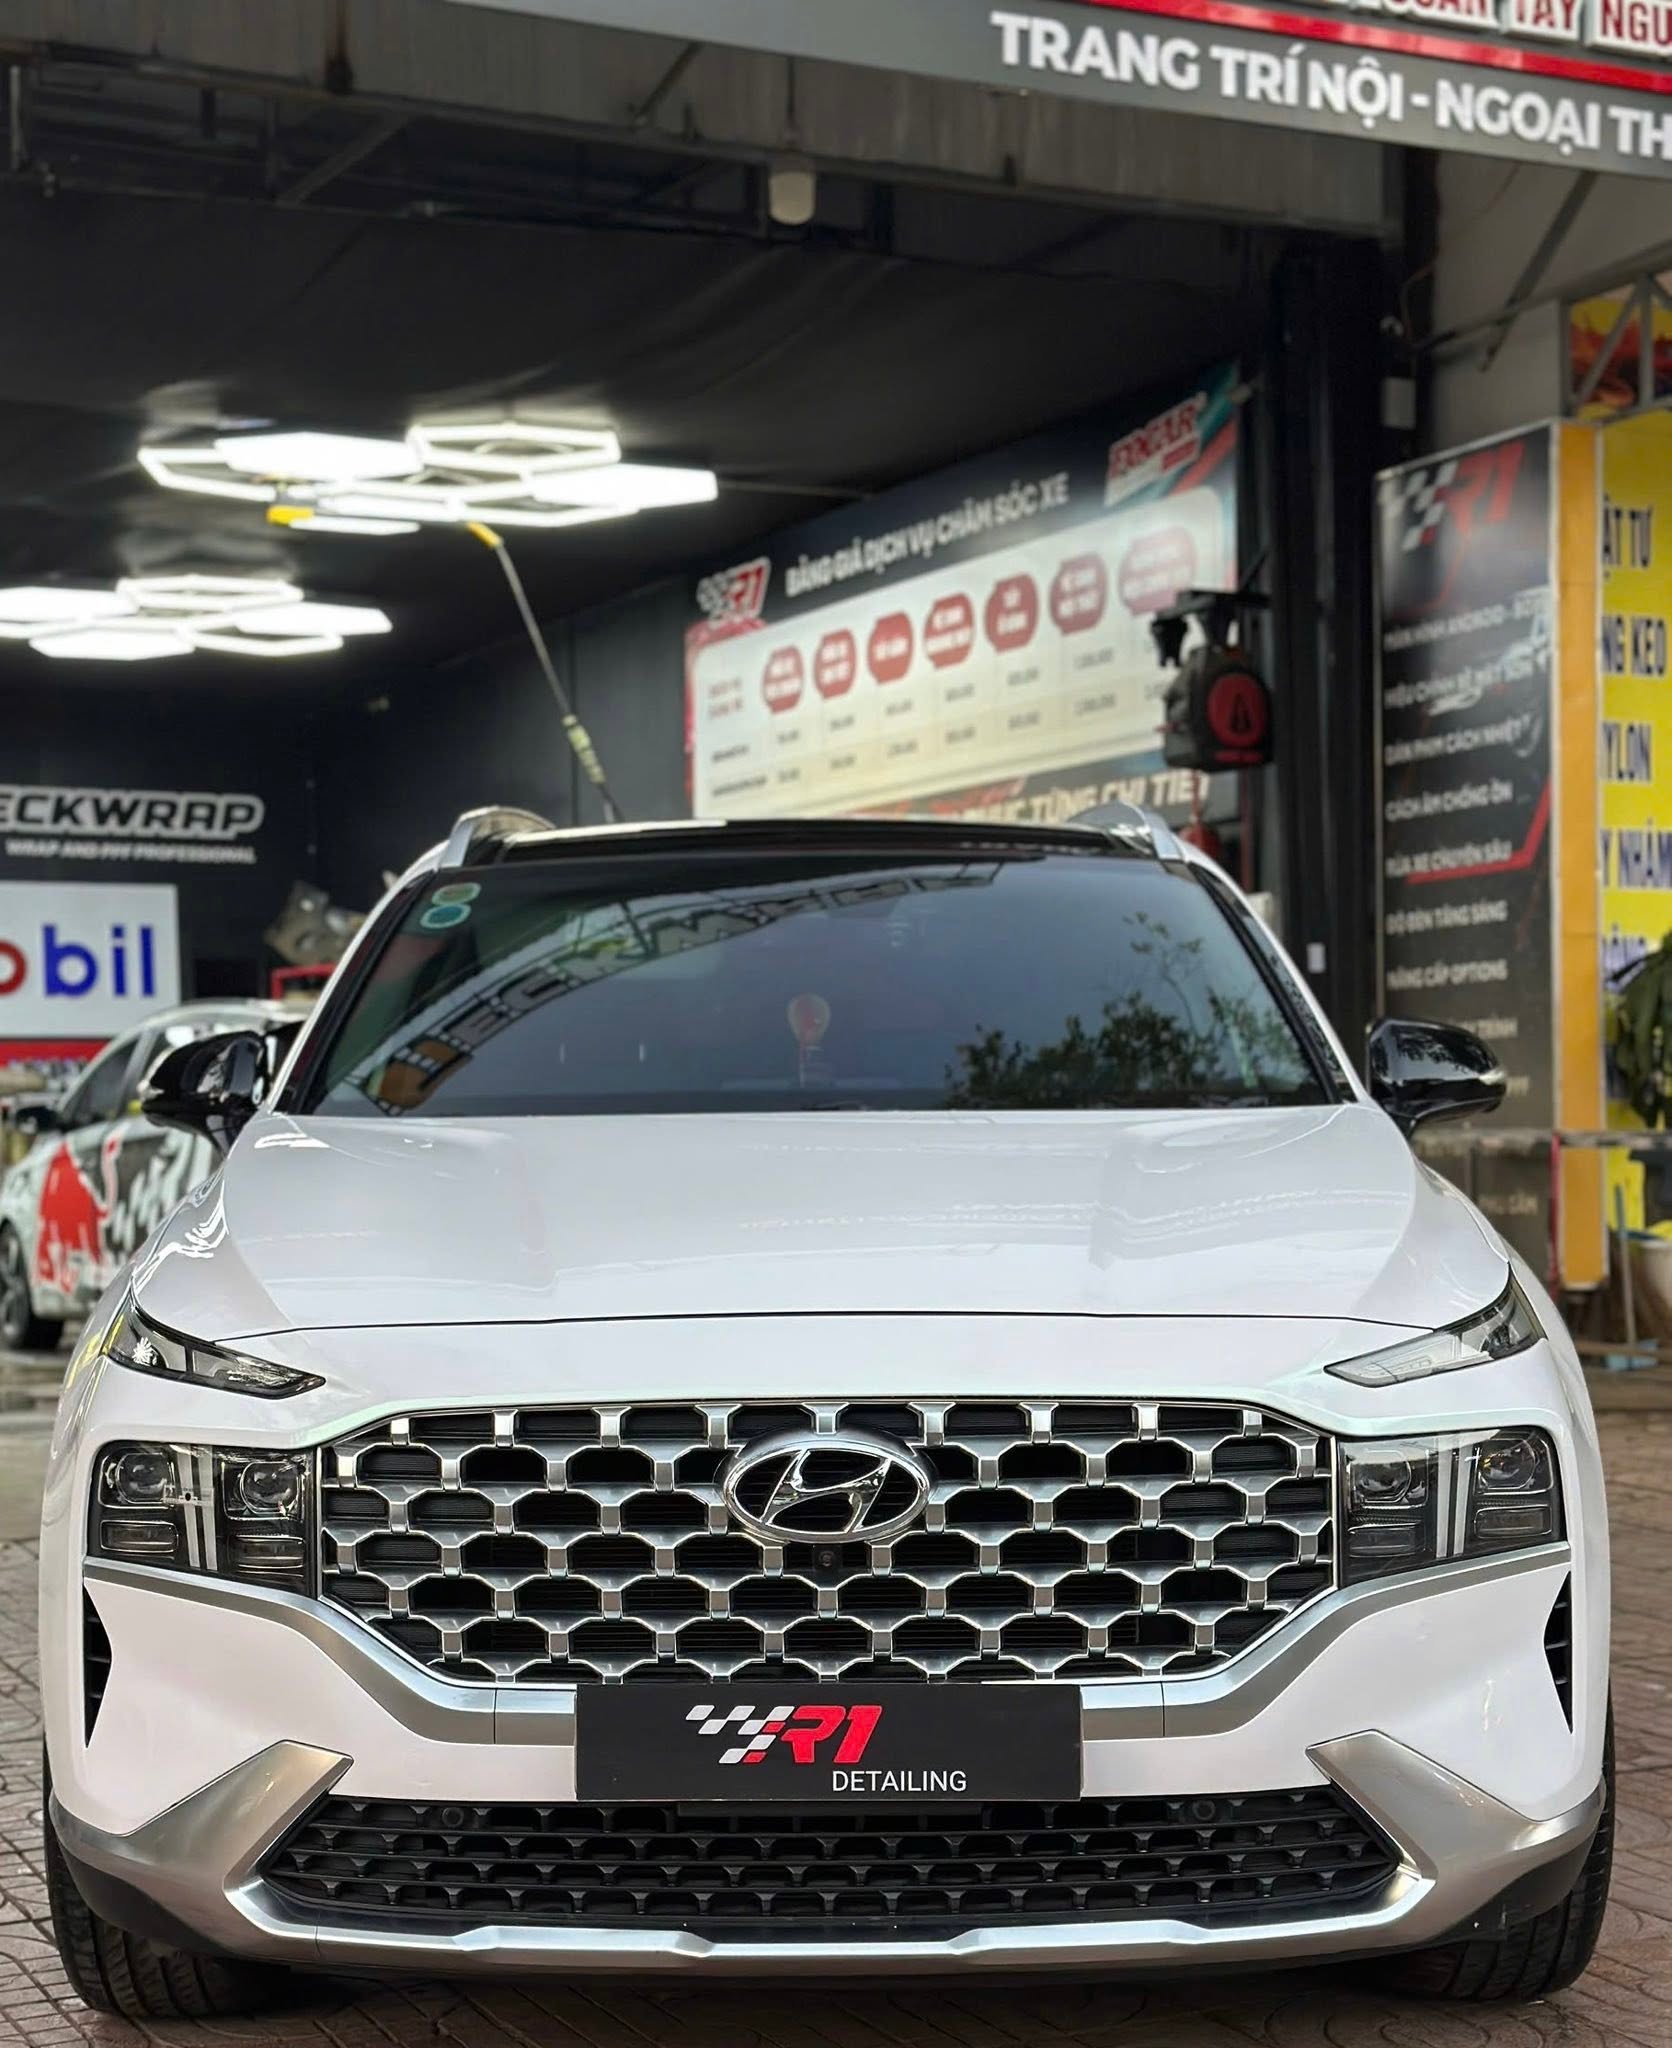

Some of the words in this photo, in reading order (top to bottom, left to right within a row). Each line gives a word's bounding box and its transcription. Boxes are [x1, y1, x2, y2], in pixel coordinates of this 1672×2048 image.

[989, 10, 1200, 91] TRANG
[1208, 42, 1305, 107] TRÍ
[1307, 55, 1404, 129] NỘI
[1435, 78, 1600, 156] NGOẠI
[1607, 105, 1672, 160] TH
[780, 1705, 882, 1764] R1
[832, 1770, 968, 1792] DETAILING
